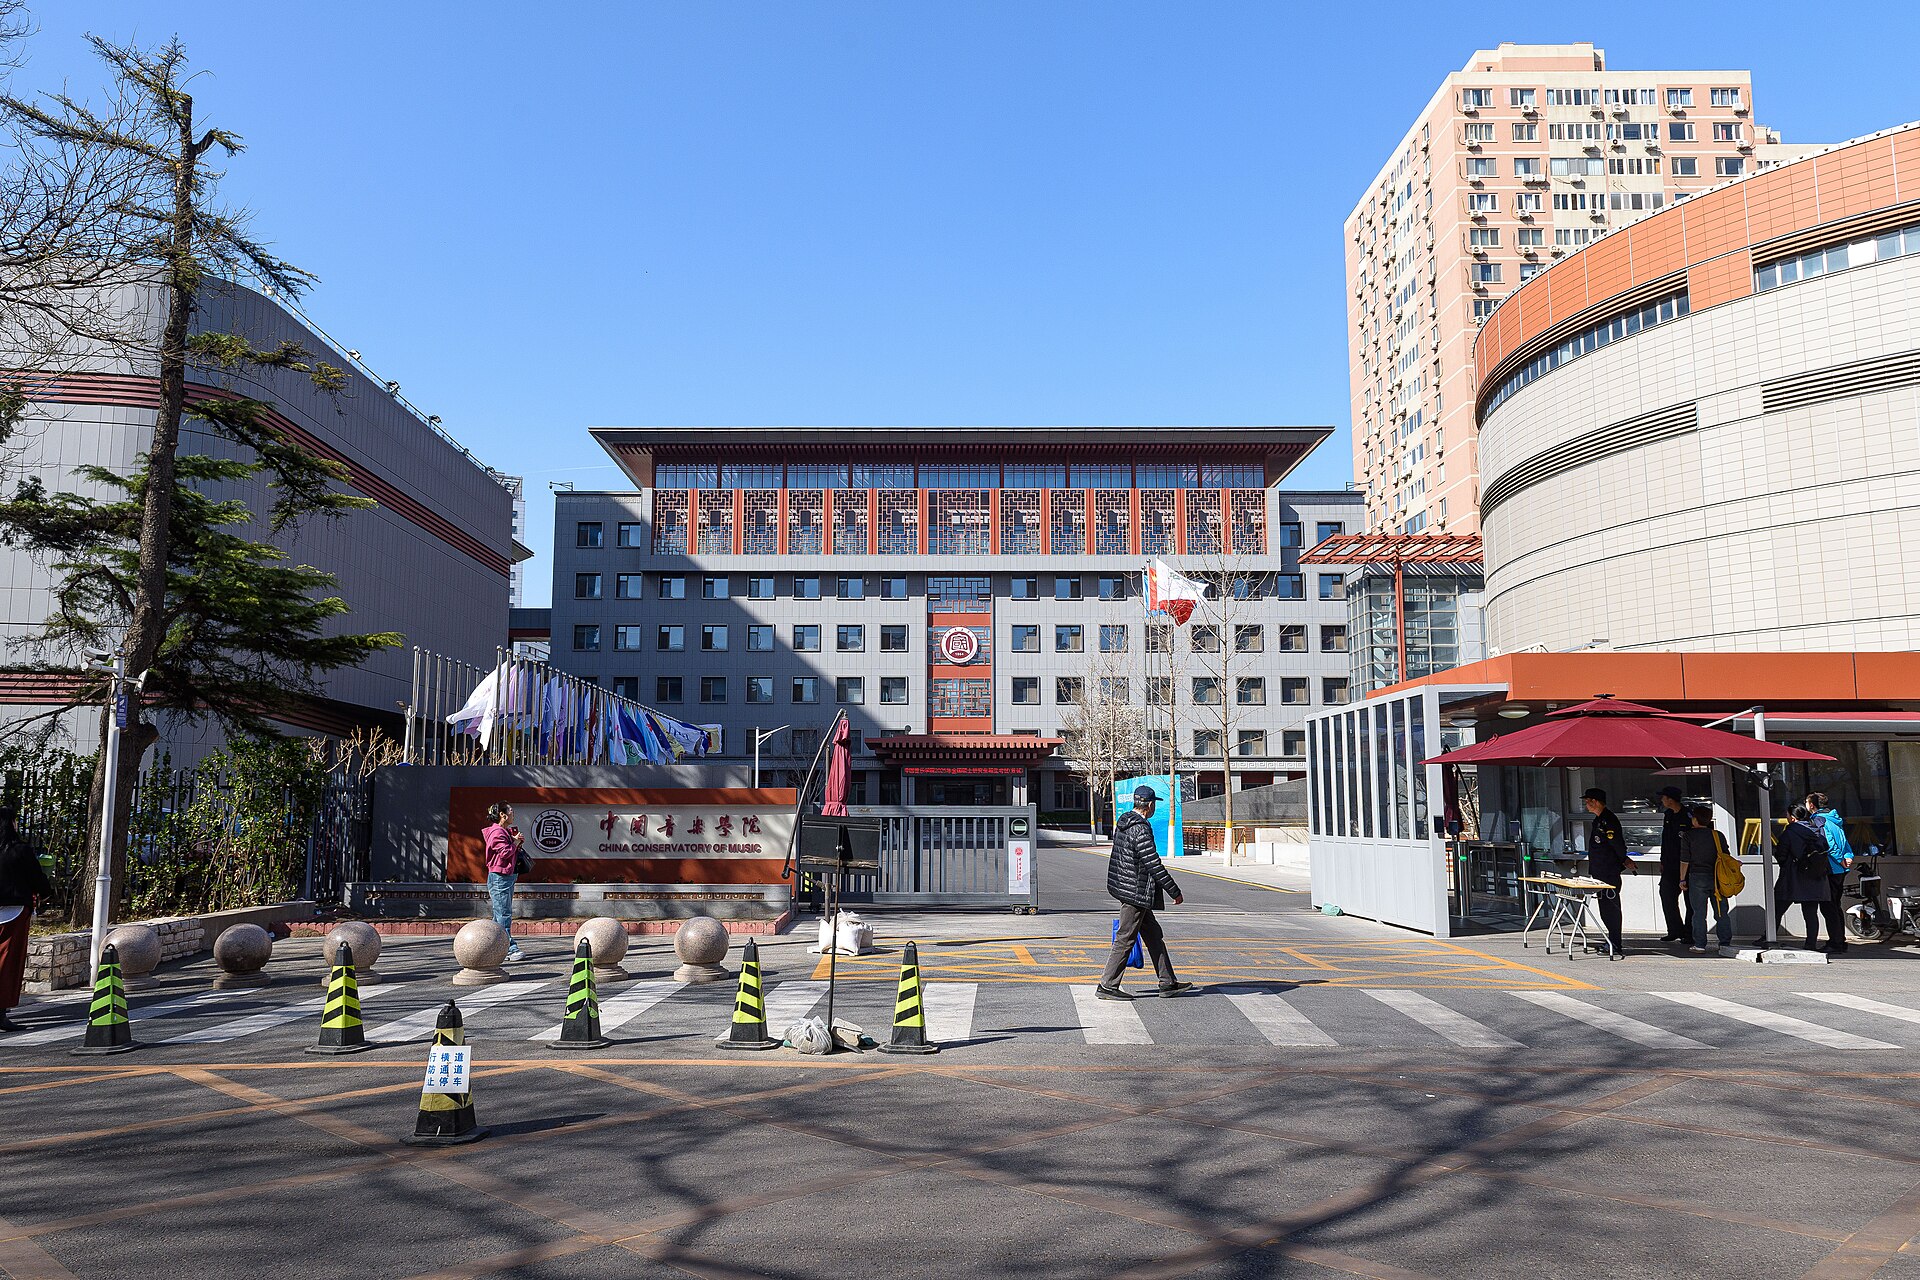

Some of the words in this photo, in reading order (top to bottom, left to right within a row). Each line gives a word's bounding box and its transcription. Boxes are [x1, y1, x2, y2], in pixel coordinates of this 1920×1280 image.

[599, 843, 630, 853] CHINA
[631, 843, 713, 853] CONSERVATORY
[713, 843, 728, 853] OF
[728, 843, 762, 853] MUSIC
